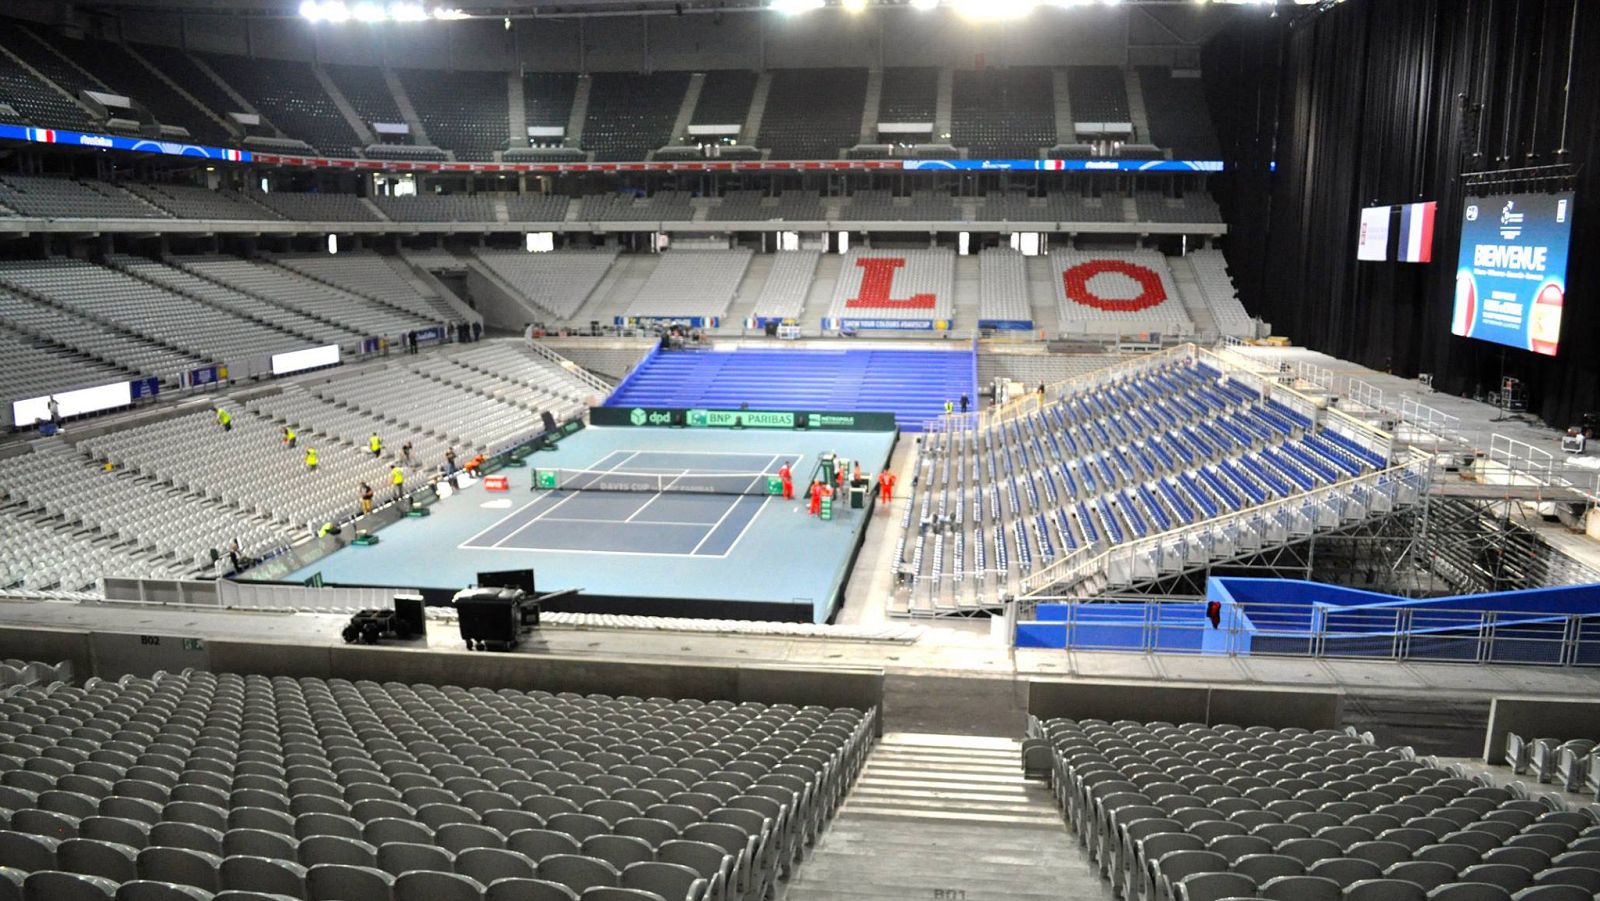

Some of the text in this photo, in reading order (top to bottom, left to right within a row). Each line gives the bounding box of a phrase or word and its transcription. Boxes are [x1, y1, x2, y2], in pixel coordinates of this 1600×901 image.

[846, 257, 1167, 312] L O
[649, 411, 671, 425] dpd
[709, 411, 792, 425] BNP PARIBAS
[600, 482, 629, 491] DAVIS
[631, 483, 650, 491] CUP
[141, 635, 160, 645] B02
